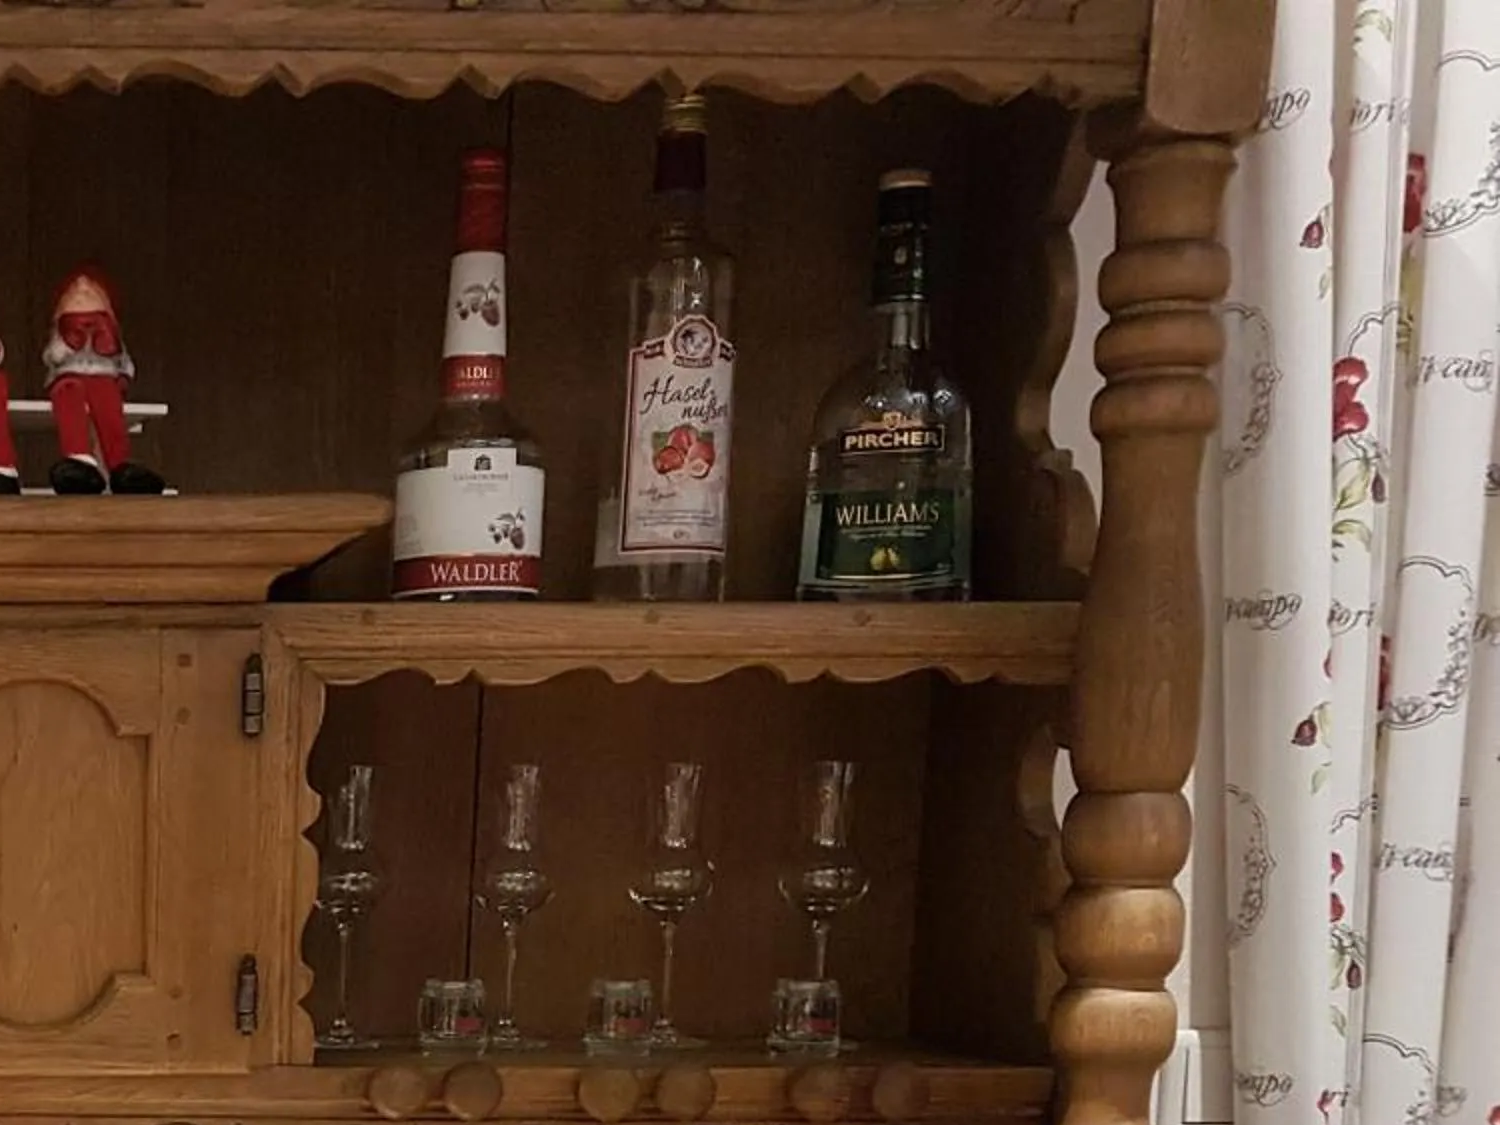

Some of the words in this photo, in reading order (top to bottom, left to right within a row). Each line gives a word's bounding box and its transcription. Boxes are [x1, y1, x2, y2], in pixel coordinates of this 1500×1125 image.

[845, 431, 939, 449] PIRCHER
[836, 501, 940, 527] WILLIAMS
[430, 560, 520, 584] WALDLER
